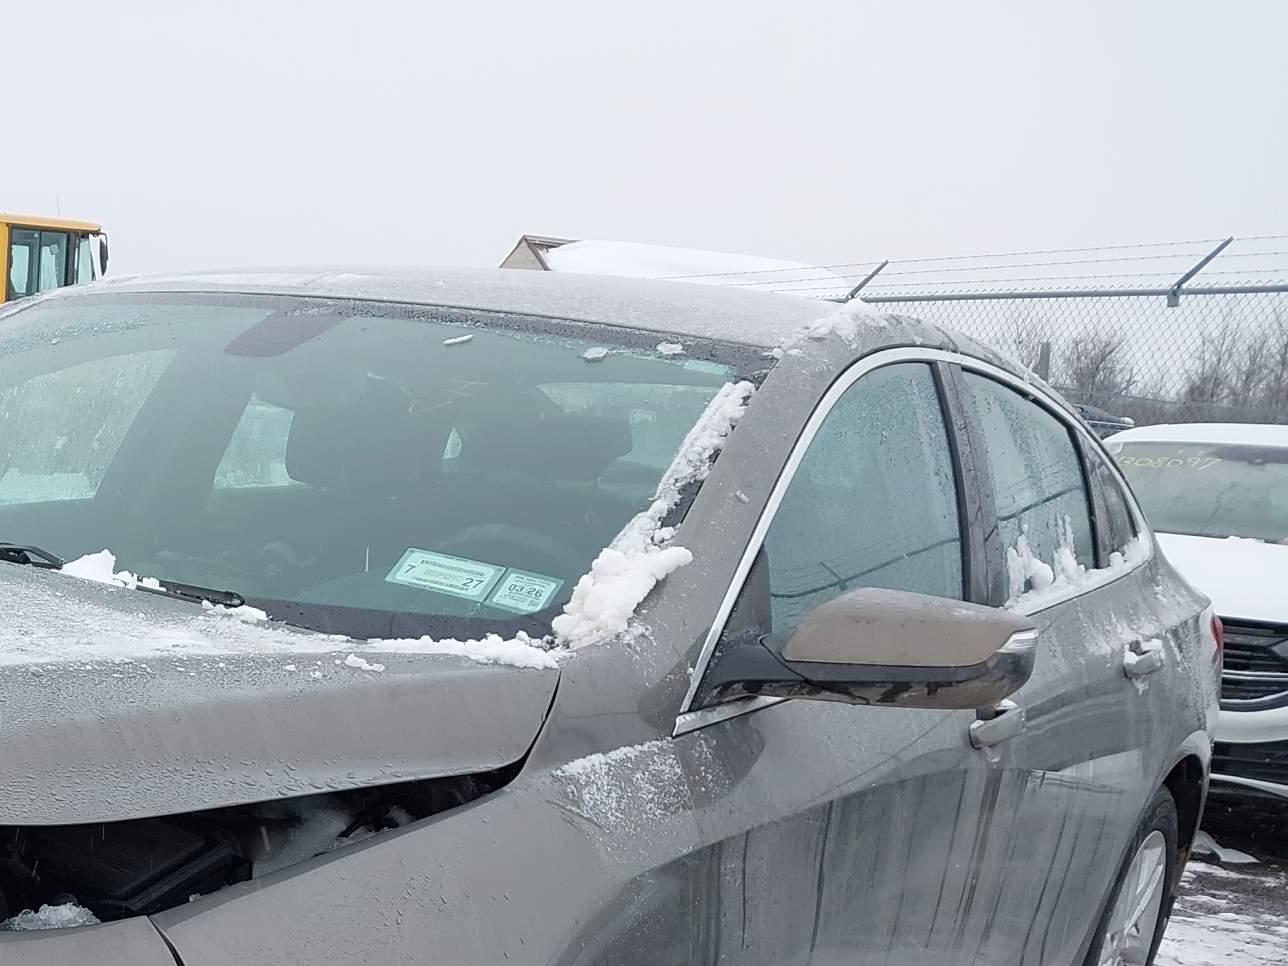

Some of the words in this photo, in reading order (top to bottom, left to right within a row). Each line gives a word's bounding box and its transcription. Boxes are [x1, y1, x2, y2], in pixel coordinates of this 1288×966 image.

[404, 564, 416, 574] 7
[462, 577, 485, 590] 27
[508, 583, 524, 594] 03
[526, 586, 544, 598] 26
